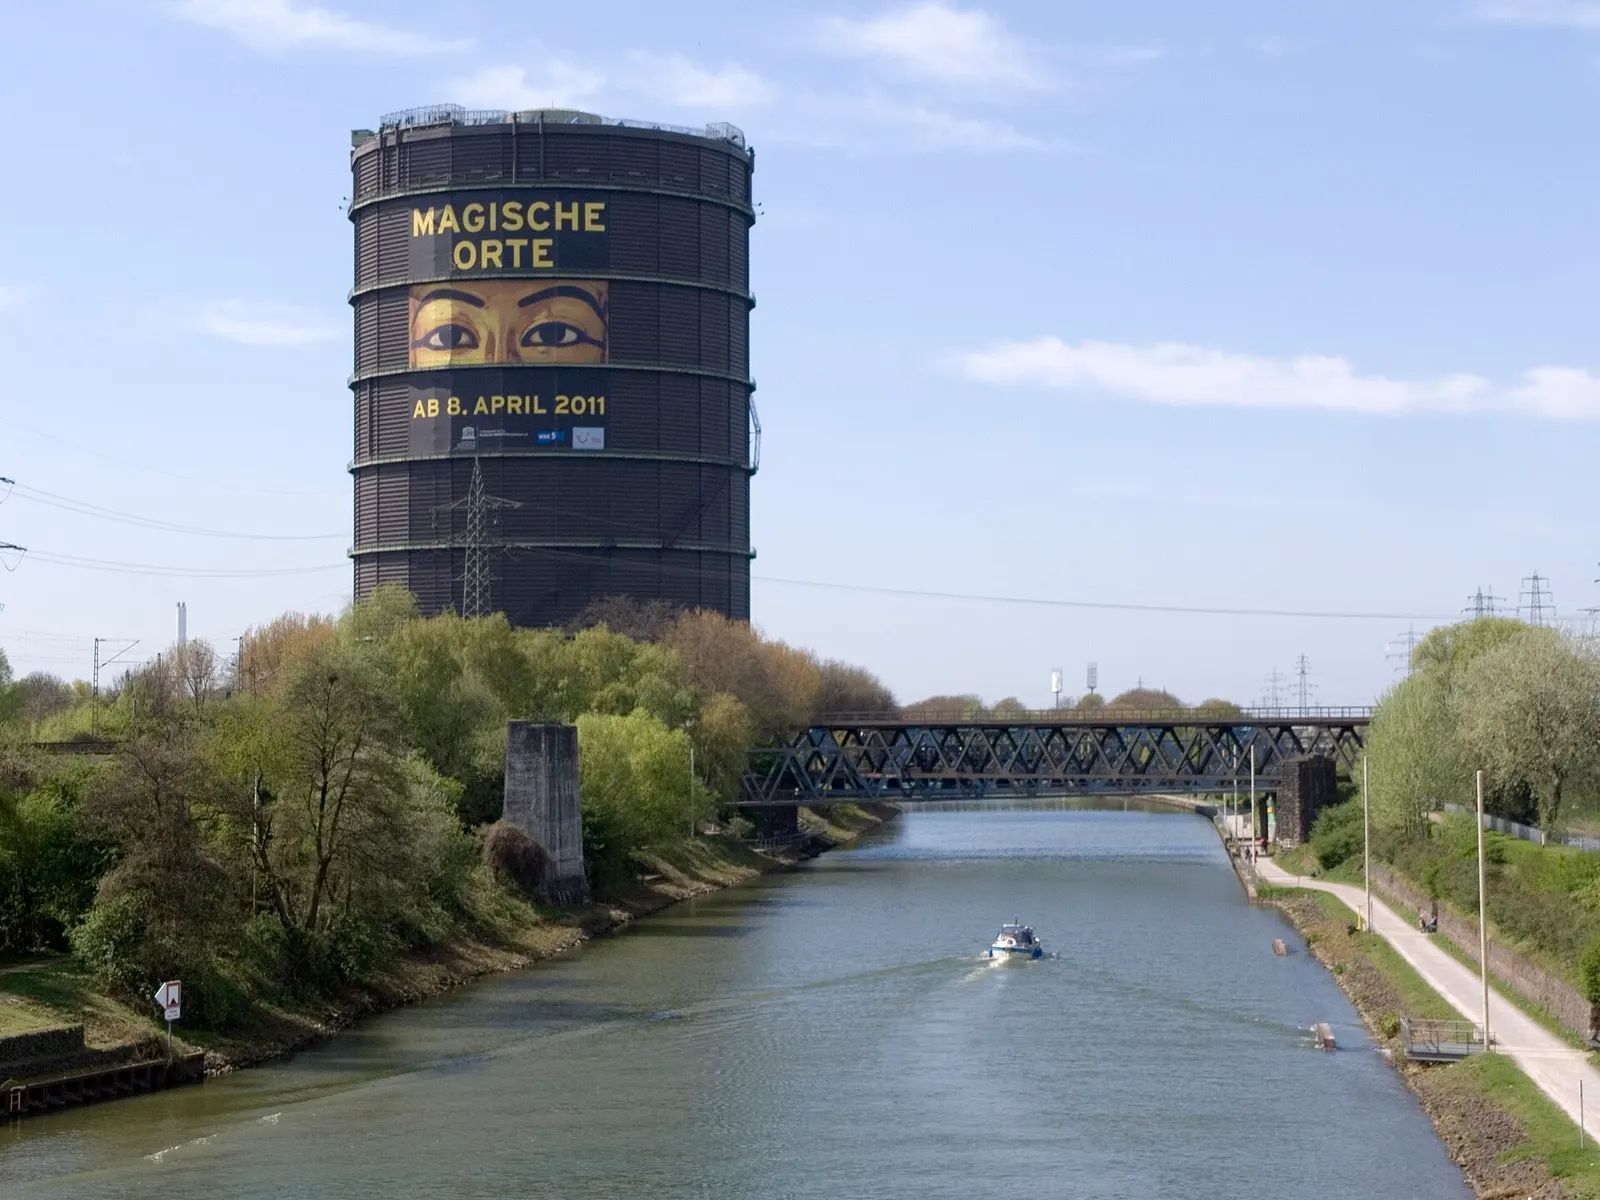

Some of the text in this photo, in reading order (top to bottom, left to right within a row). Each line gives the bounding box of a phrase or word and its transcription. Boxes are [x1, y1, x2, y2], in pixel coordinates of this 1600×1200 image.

[412, 201, 606, 238] MAGISCHE
[453, 239, 554, 270] ORTE
[412, 395, 605, 418] AB 8. APRIL 2011
